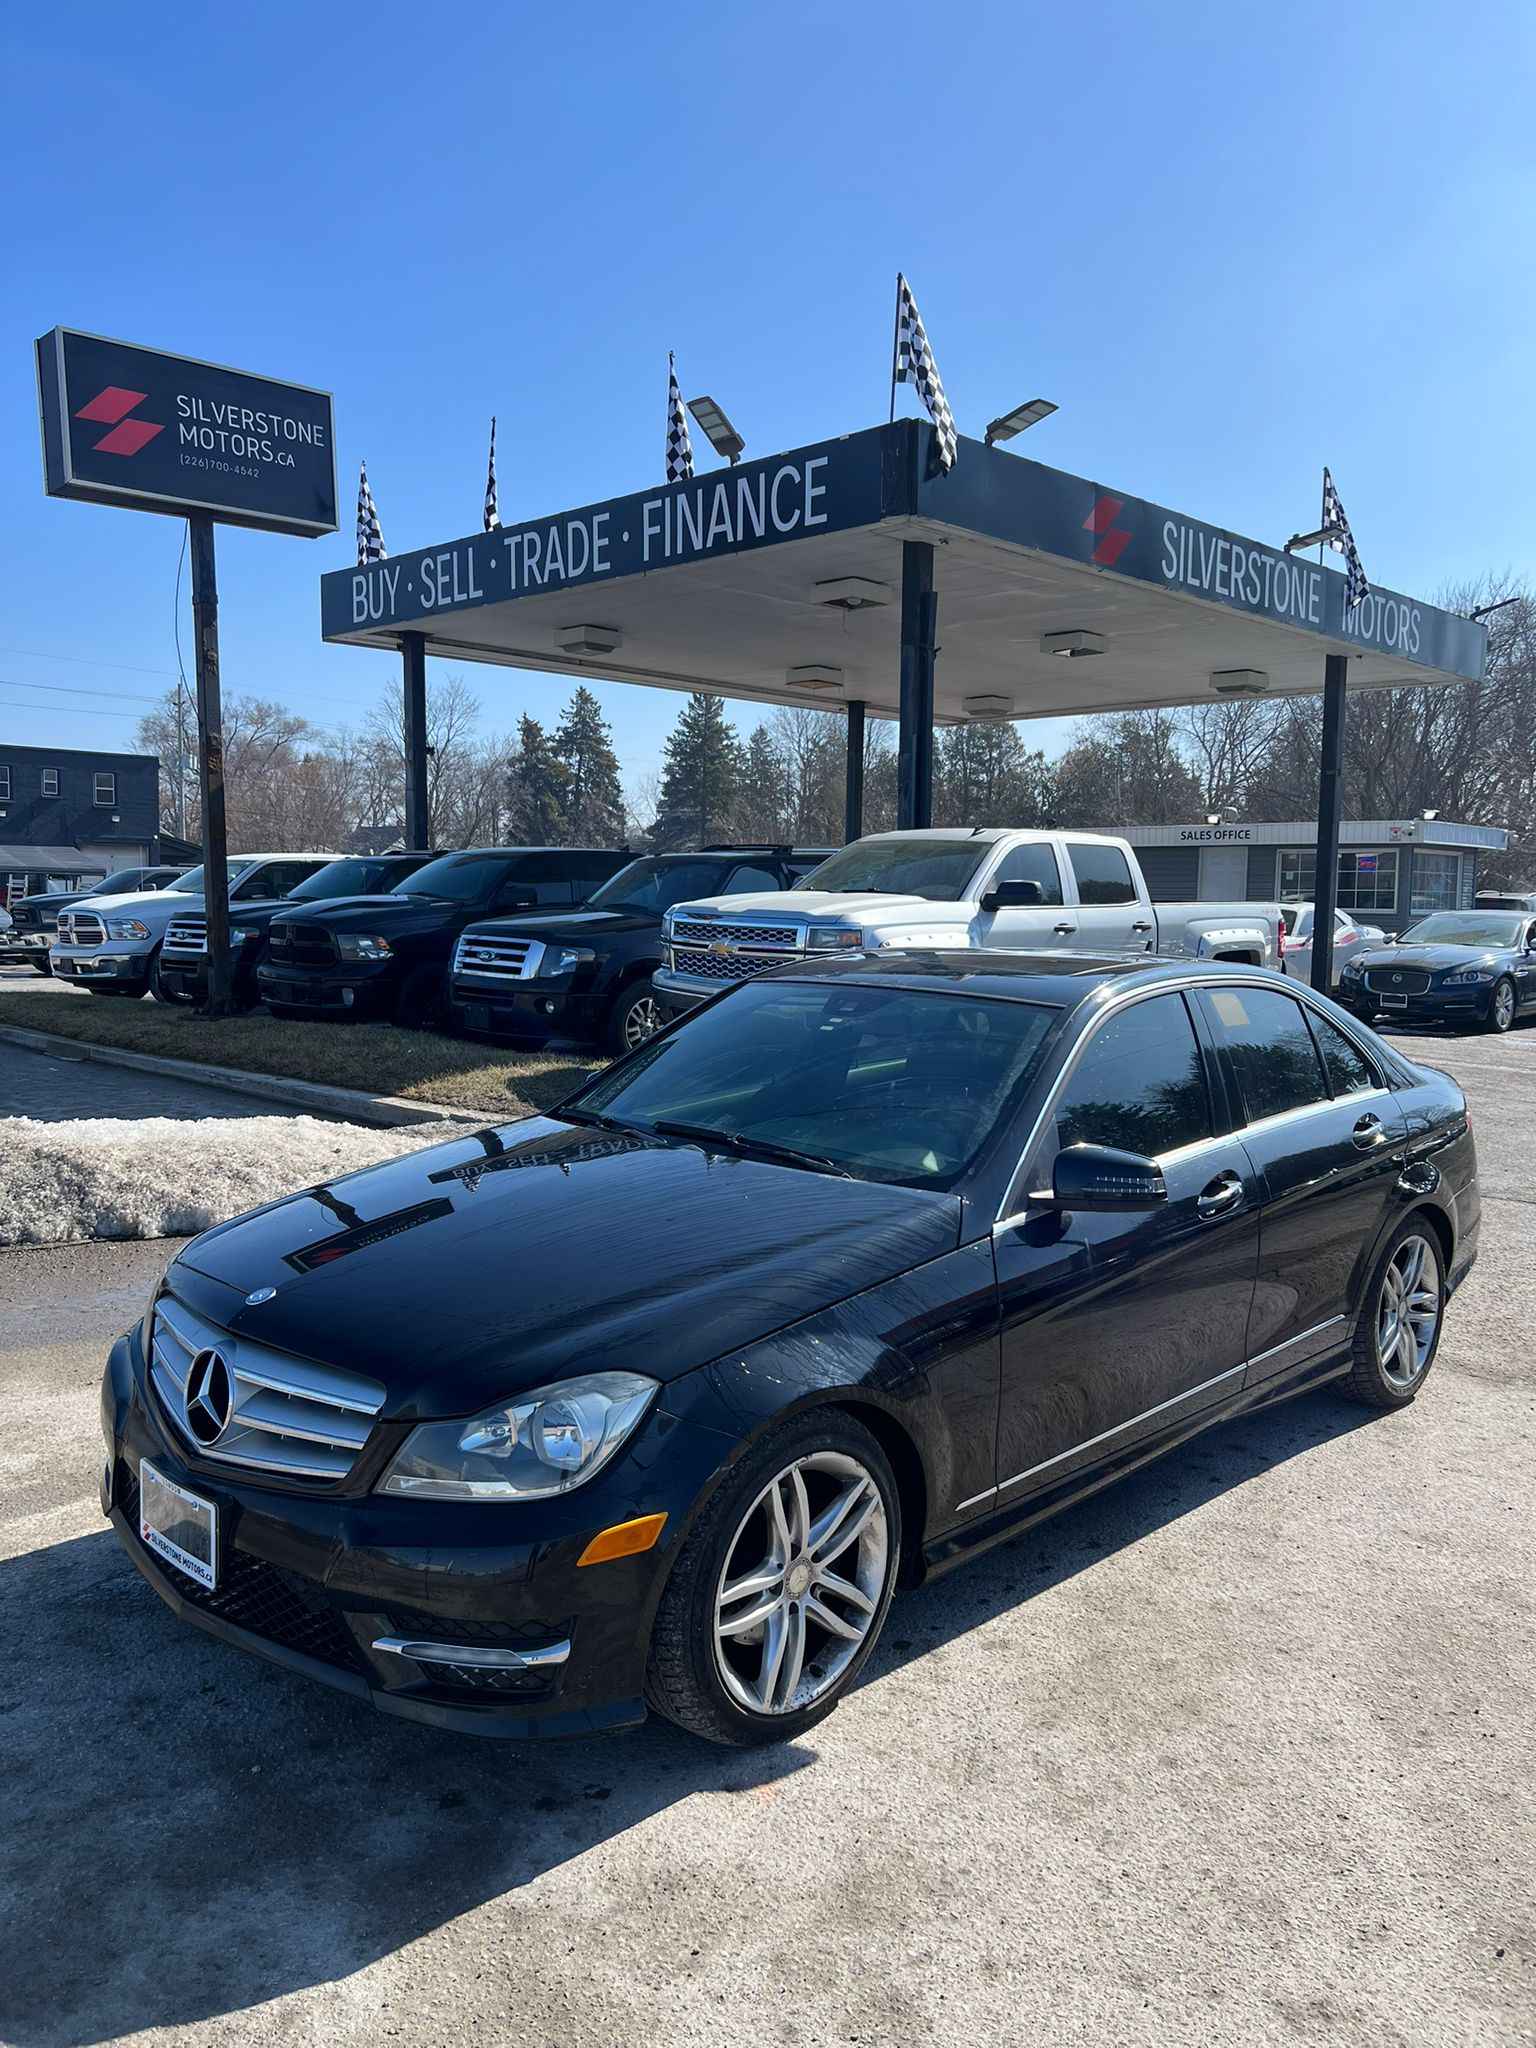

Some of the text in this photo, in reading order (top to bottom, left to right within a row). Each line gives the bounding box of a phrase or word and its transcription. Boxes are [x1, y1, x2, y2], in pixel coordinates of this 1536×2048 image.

[176, 394, 325, 447] SILVERSTONE
[179, 423, 295, 468] MOTORS.CA
[352, 456, 829, 624] BUY SELL TRADE FINANCE
[1161, 520, 1321, 625] SILVERSTONE
[1180, 830, 1251, 841] SALES OFFICE
